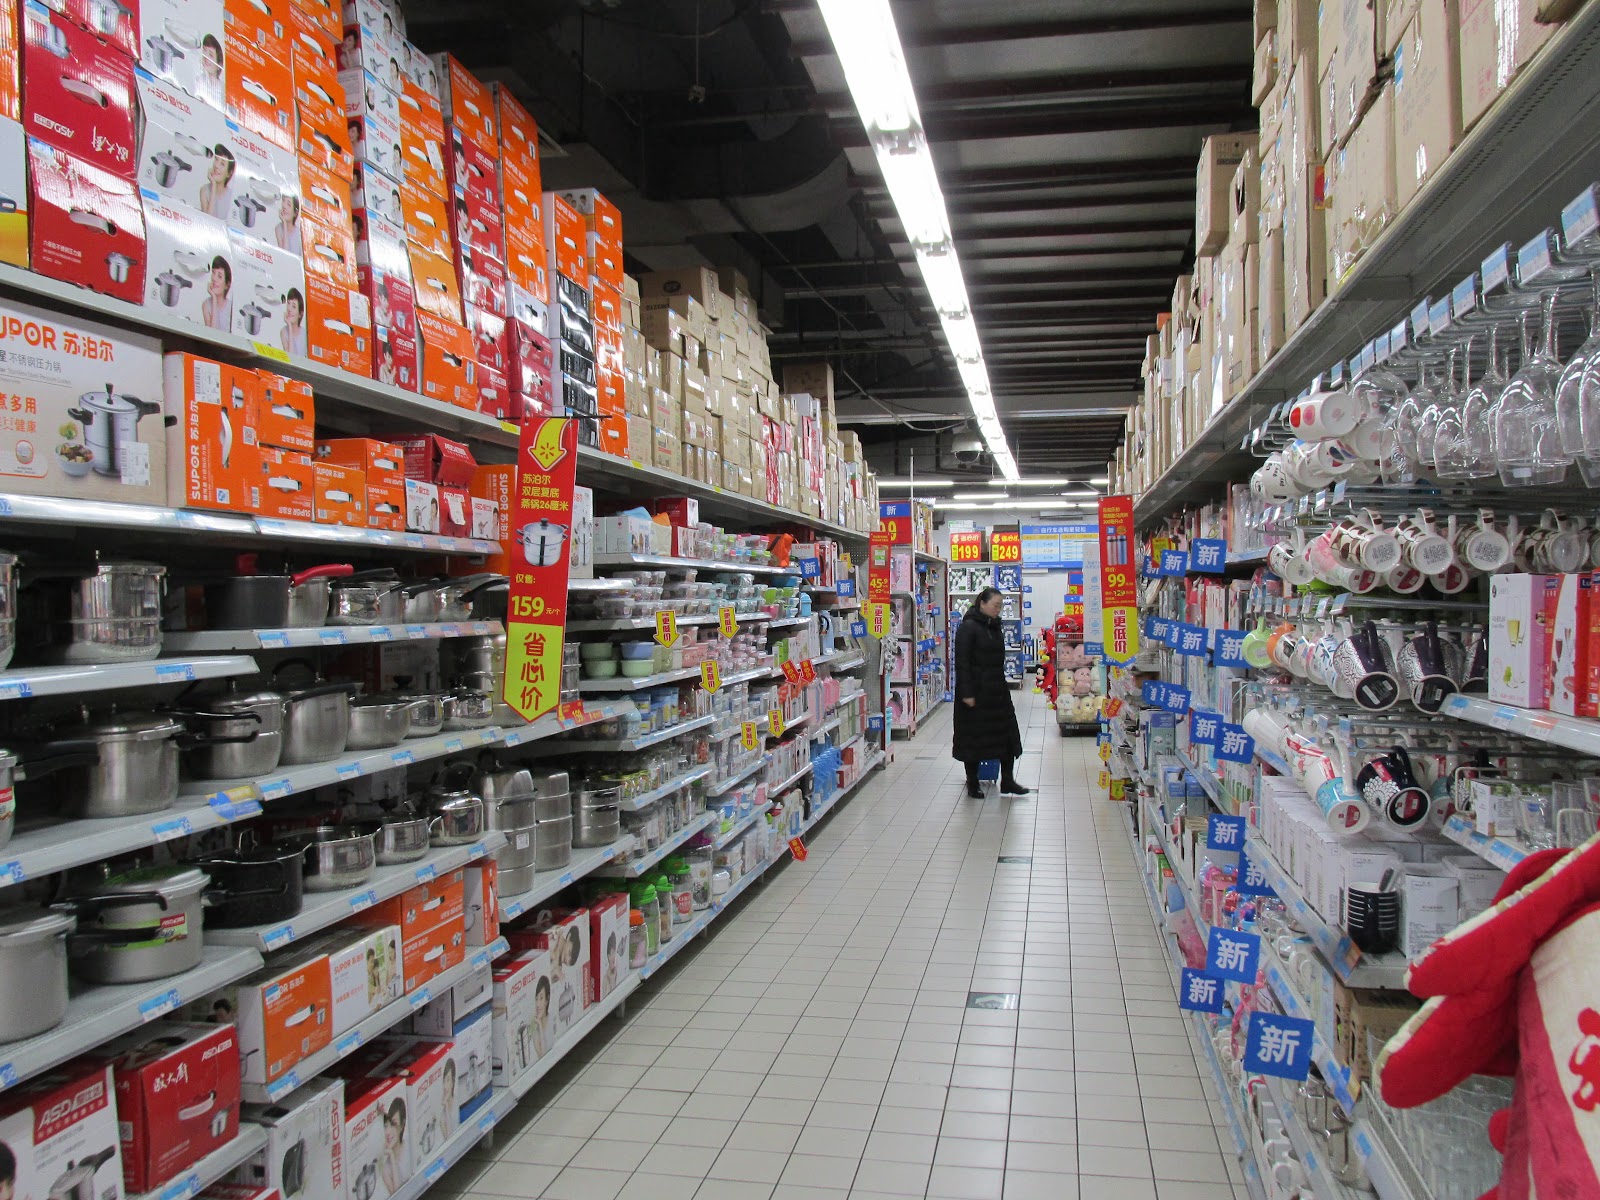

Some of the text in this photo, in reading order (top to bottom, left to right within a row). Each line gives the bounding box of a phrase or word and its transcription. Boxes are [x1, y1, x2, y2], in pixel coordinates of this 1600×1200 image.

[309, 277, 330, 295] SUPOR
[420, 314, 443, 332] SUPOR
[63, 330, 114, 362] 苏泊尔
[9, 351, 62, 374] 不锈钢压力锅
[191, 444, 201, 500] SUPOR
[522, 473, 551, 485] 苏泊尔
[500, 473, 509, 510] SUPOR
[522, 487, 560, 499] 双层复底
[521, 498, 569, 511] 蒸锅26厘米
[959, 545, 979, 559] 199
[1000, 545, 1019, 560] 249
[1198, 545, 1220, 566] 新
[804, 561, 816, 574] 新
[1164, 554, 1182, 572] 新
[840, 582, 850, 595] 新
[1108, 573, 1126, 588] 99
[511, 595, 561, 617] 159 元/个
[854, 623, 864, 635] 新
[1114, 616, 1127, 655] 更低价
[1152, 622, 1168, 638] 新
[1182, 631, 1203, 651] 新
[1221, 636, 1243, 661] 新
[520, 632, 547, 712] 省心价
[1167, 692, 1186, 709] 新
[1196, 719, 1217, 739] 新
[1222, 731, 1248, 756] 新
[1214, 821, 1238, 845] 新
[1215, 938, 1250, 973] 新
[1188, 976, 1217, 1005] 新
[201, 1047, 218, 1062] ASD
[1257, 1024, 1300, 1067] 新
[38, 1099, 72, 1130] ASD
[351, 1119, 367, 1142] ASD
[331, 1099, 342, 1190] ASD 爱仕达
